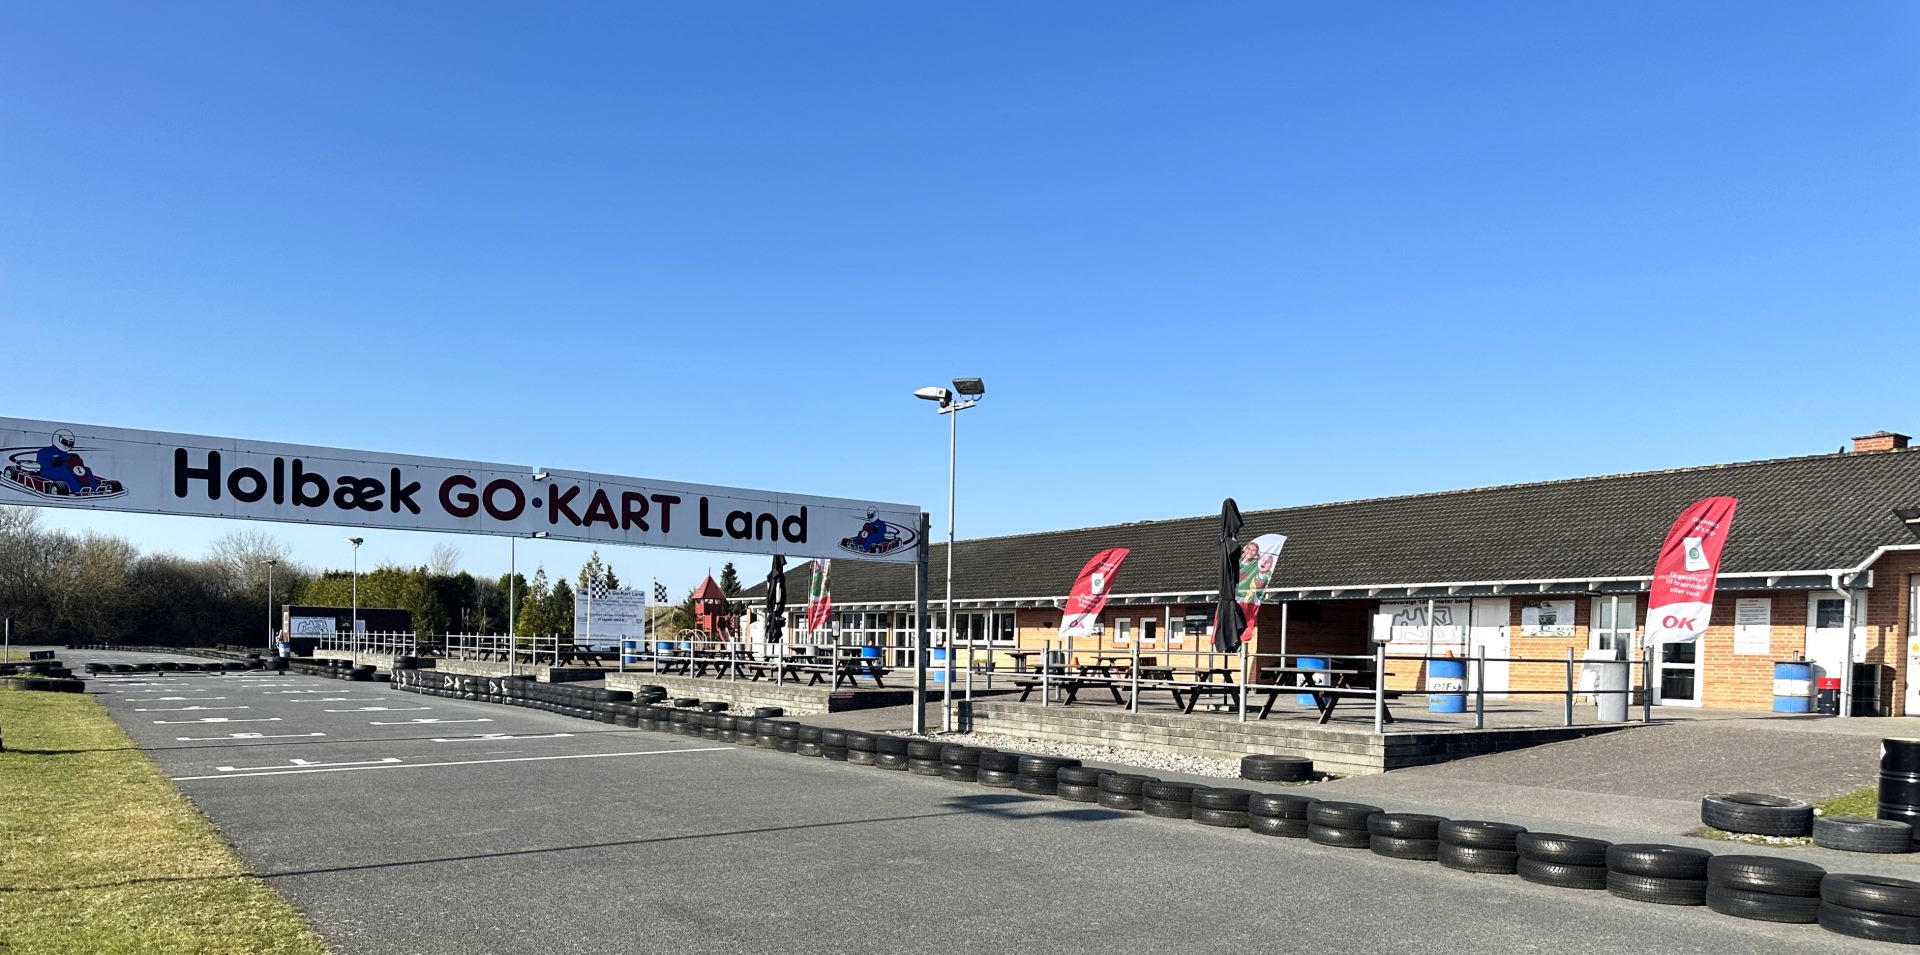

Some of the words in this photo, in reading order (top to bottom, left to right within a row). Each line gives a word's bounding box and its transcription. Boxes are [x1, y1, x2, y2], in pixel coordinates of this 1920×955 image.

[174, 447, 422, 515] Holbæk
[699, 496, 808, 544] Land
[1669, 587, 1685, 595] eller
[1662, 615, 1698, 631] OK
